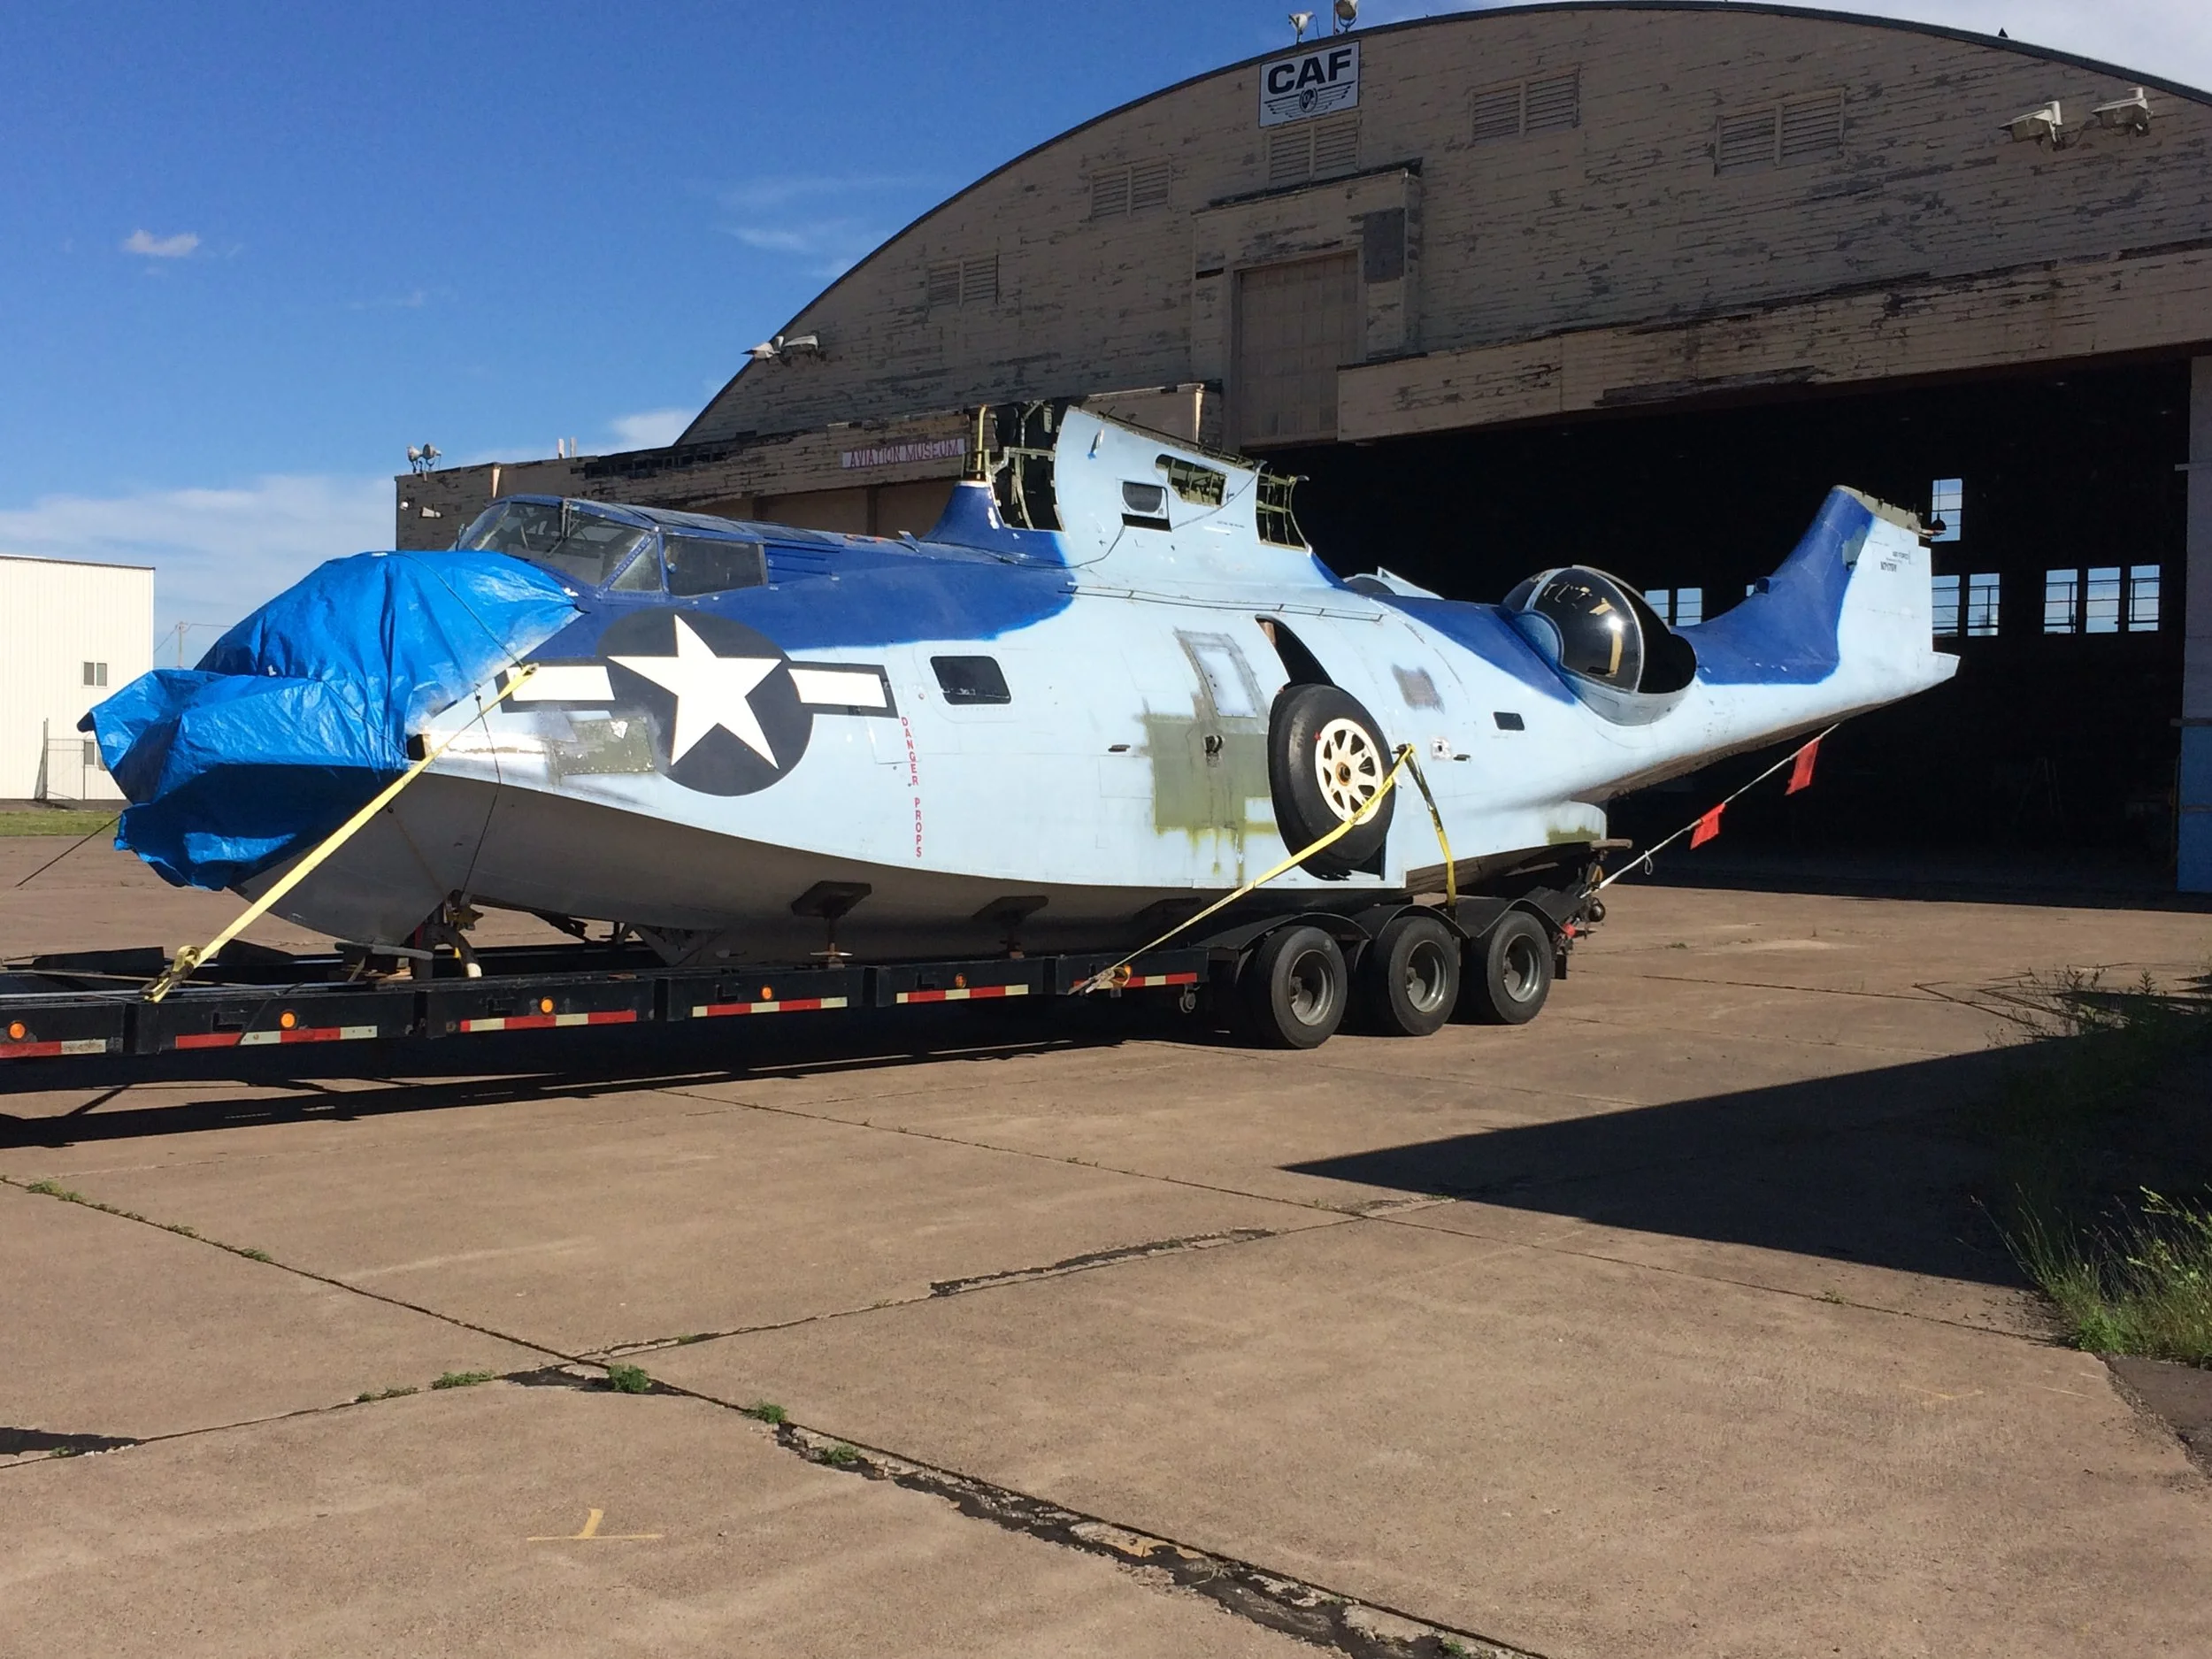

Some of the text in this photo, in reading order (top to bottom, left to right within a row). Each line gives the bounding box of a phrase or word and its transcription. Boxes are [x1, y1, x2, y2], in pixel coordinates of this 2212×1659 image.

[1268, 48, 1352, 95] CAF
[849, 439, 959, 468] AVIATION MUSEUM
[901, 717, 918, 786] DANGER
